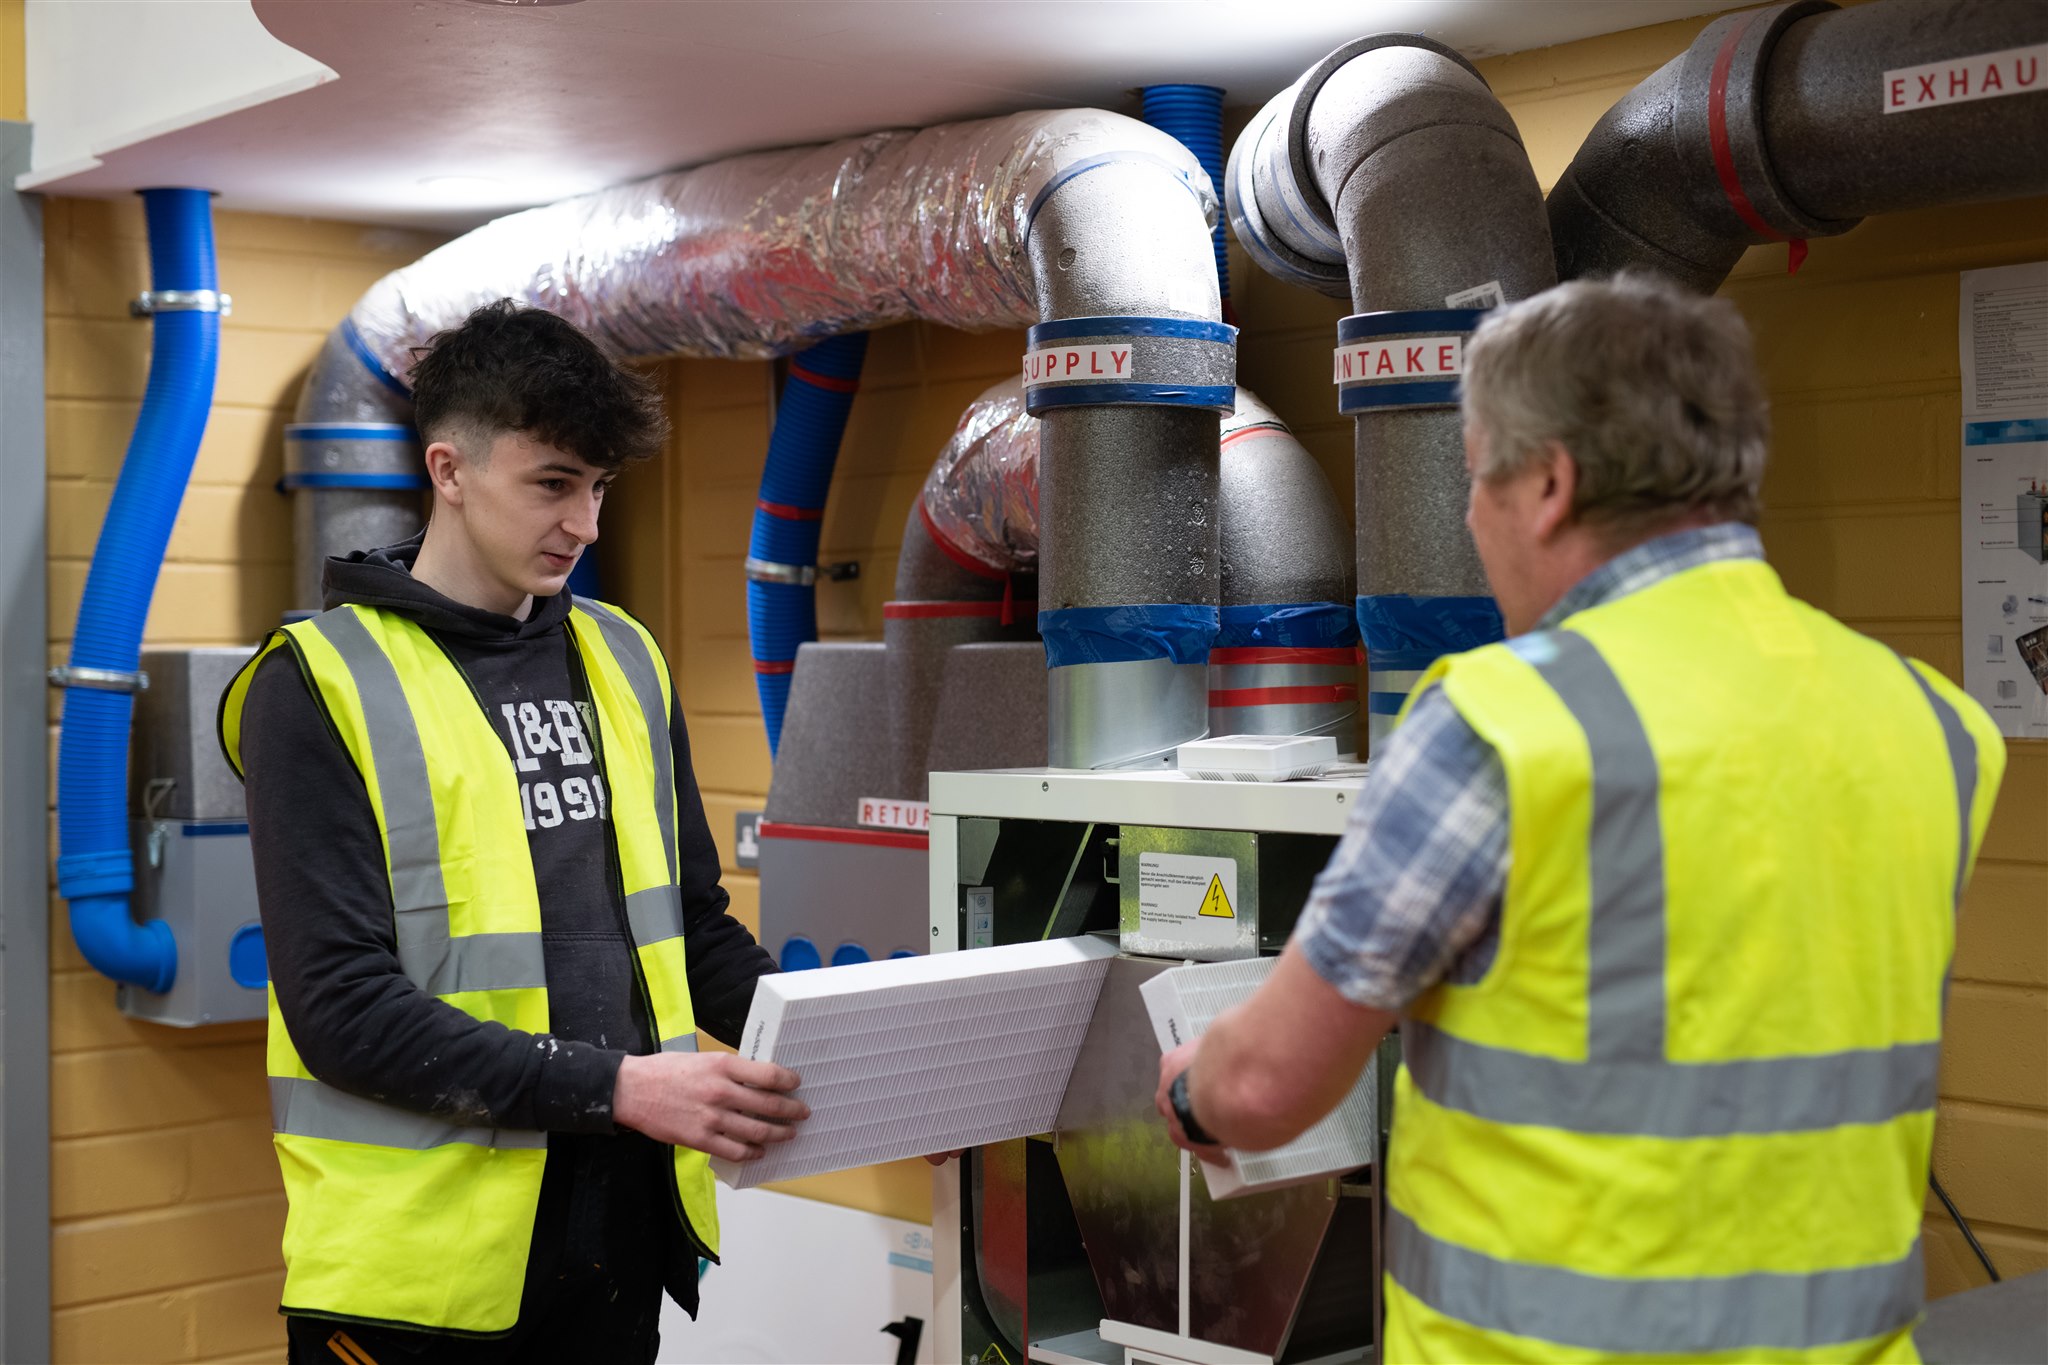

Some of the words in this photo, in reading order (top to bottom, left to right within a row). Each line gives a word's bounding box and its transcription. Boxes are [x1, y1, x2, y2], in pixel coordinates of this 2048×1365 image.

[1891, 56, 2037, 106] EXHAU
[1024, 351, 1128, 382] SUPPLY
[1336, 345, 1454, 381] INTAKE
